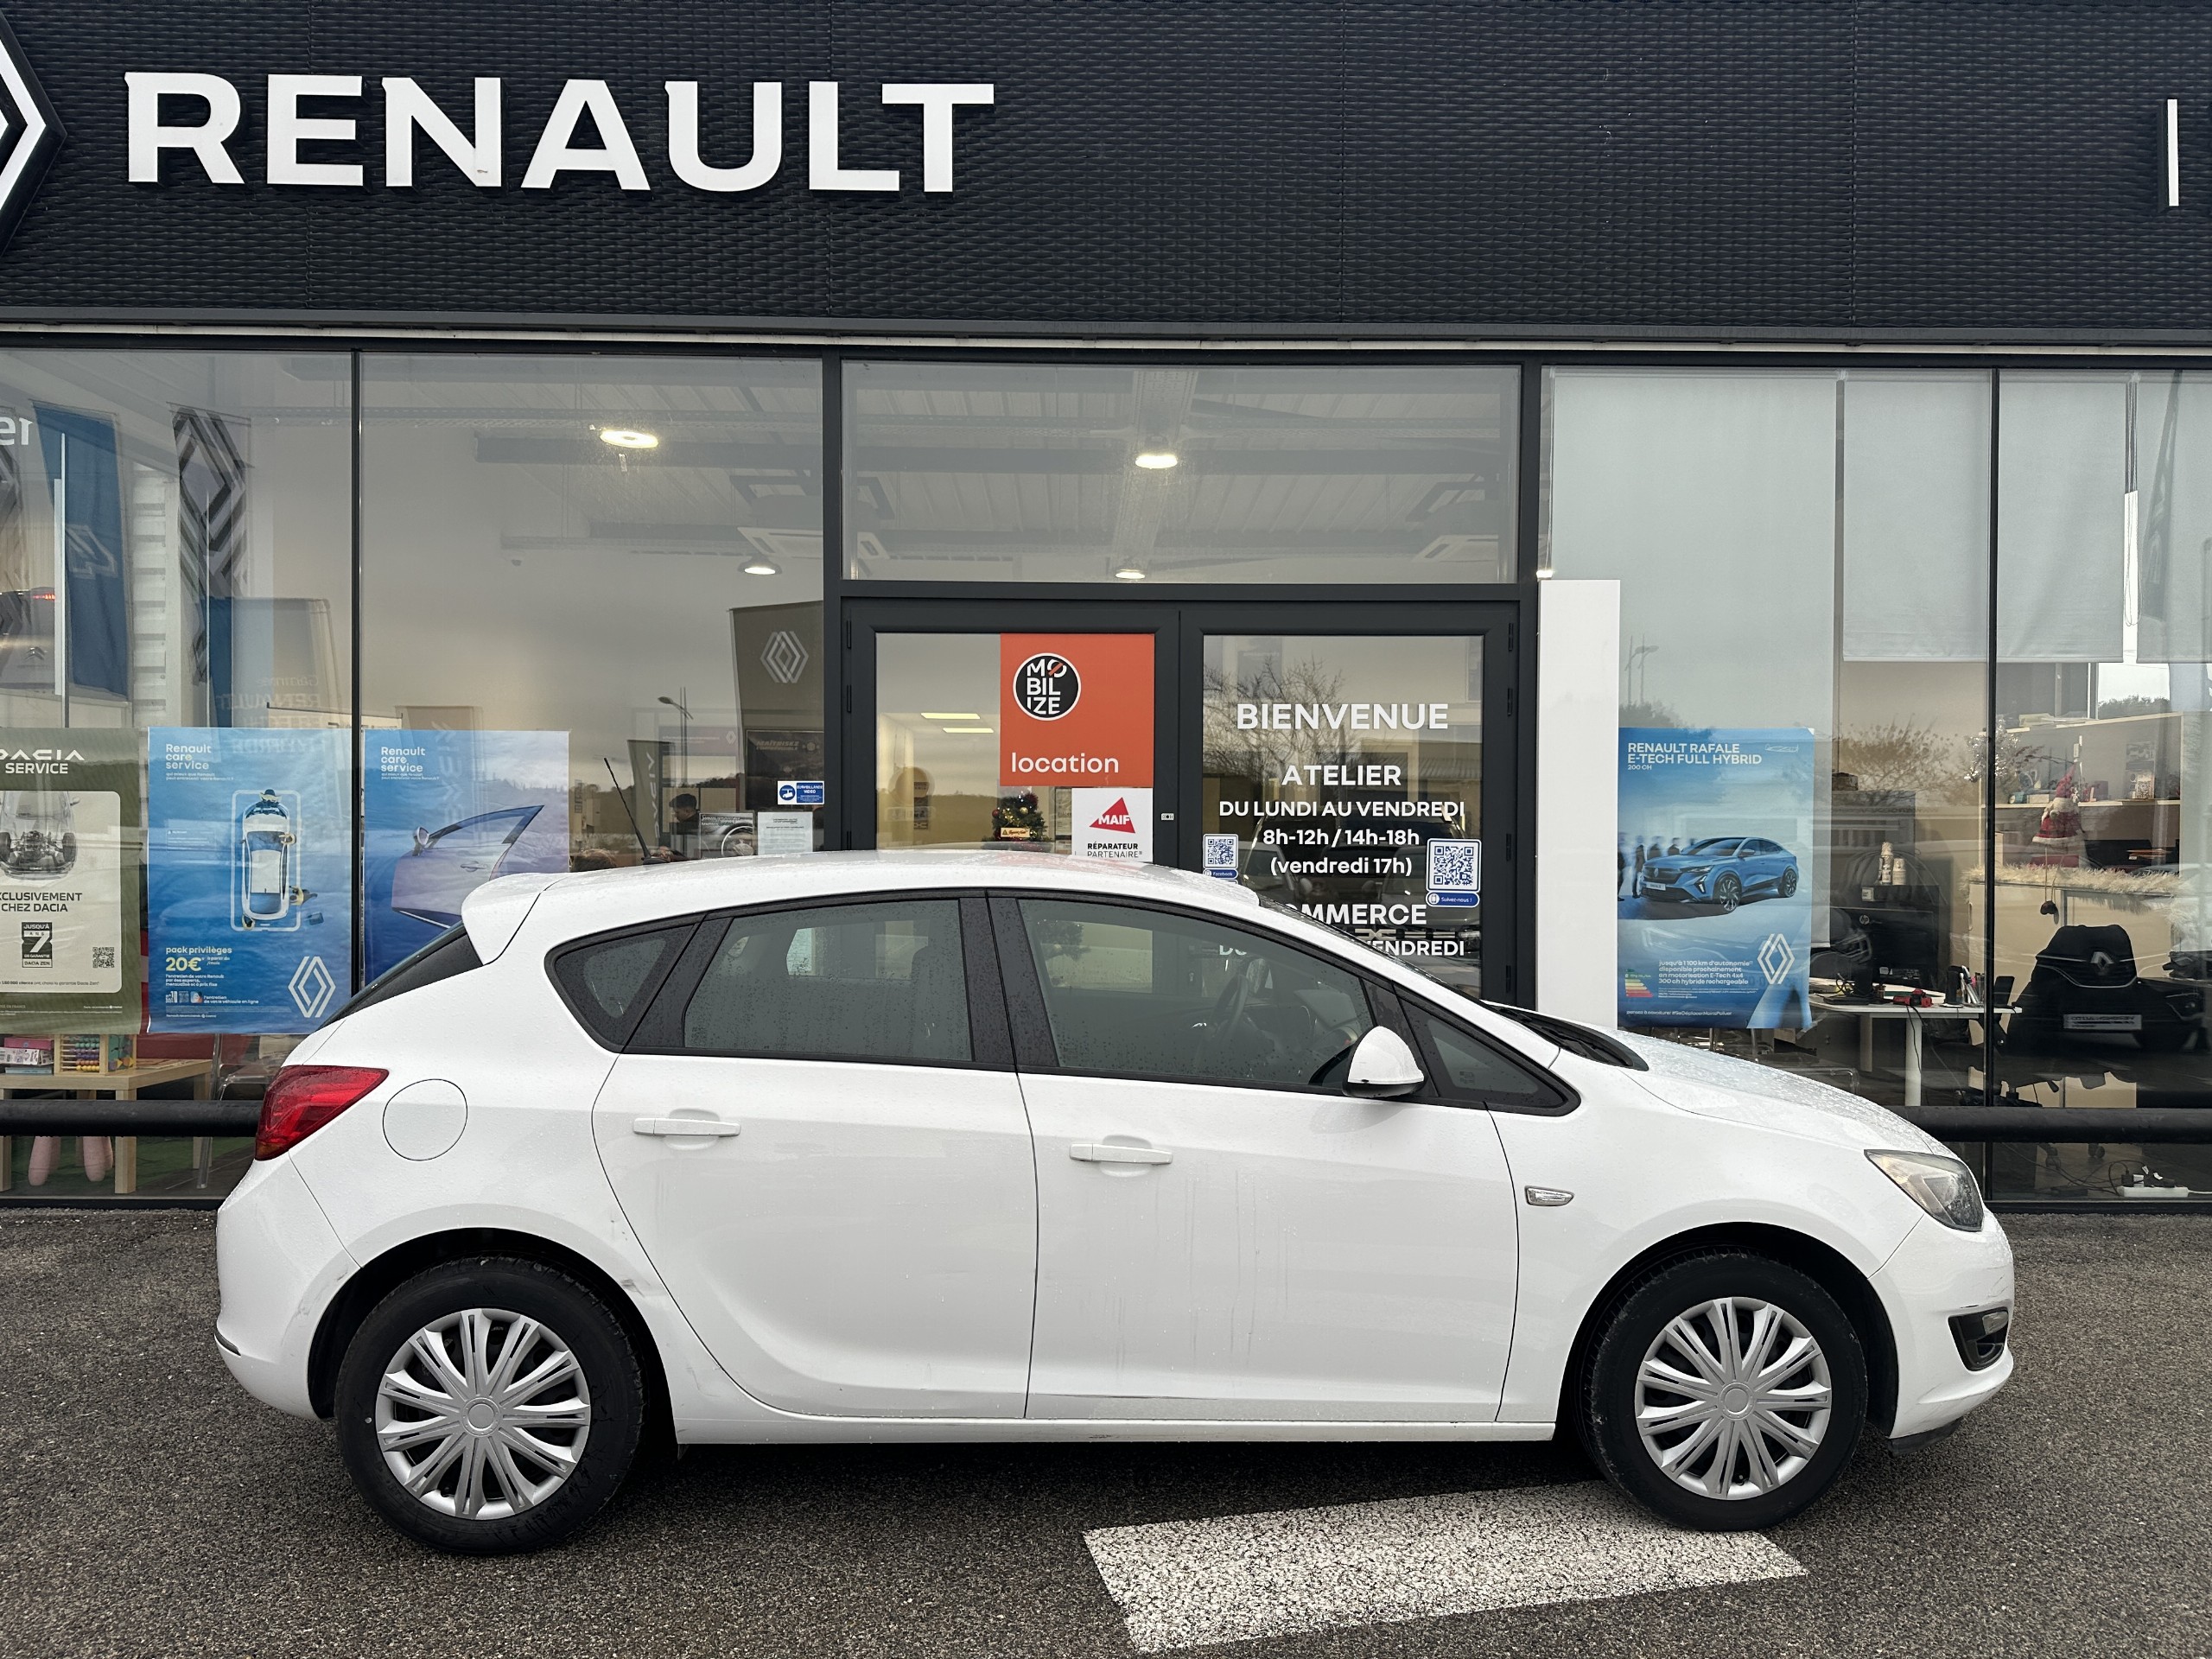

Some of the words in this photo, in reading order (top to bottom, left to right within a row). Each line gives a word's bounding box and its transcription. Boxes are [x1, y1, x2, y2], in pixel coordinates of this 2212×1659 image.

[125, 71, 994, 193] RENAULT
[0, 416, 33, 445] er
[1236, 703, 1449, 730] BIENVENUE
[166, 744, 212, 753] Renault
[381, 747, 426, 755] Renault
[1627, 743, 1687, 753] RENAULT
[1689, 743, 1740, 753] RAFALE
[1011, 753, 1119, 774] location
[1627, 754, 1675, 764] E-TECH
[1677, 754, 1710, 764] FULL
[1713, 754, 1762, 764] HYBRID
[5, 762, 68, 774] SERVICE
[166, 760, 209, 770] service
[381, 763, 423, 772] service
[1281, 765, 1402, 786] ATELIER
[1219, 801, 1249, 817] DU
[1254, 801, 1317, 817] LUNDI
[1321, 801, 1351, 817] AU
[1356, 801, 1465, 817] VENDREDI
[1098, 815, 1130, 825] MAIF
[1262, 830, 1329, 845] 8h-12h
[1332, 829, 1341, 848] /
[1345, 830, 1421, 845] 14h-18h
[1087, 841, 1139, 849] RÉPARATEUR
[1271, 857, 1370, 876] (vendredi
[1373, 857, 1413, 876] 17h)
[0, 893, 83, 901] CLUSIVEMENT
[1, 903, 31, 912] CHEZ
[34, 903, 68, 912] DACIA
[1285, 903, 1427, 925] MMERCE
[166, 946, 188, 955] pack
[188, 946, 232, 955] privilèges
[1367, 940, 1465, 956] ENDREDI
